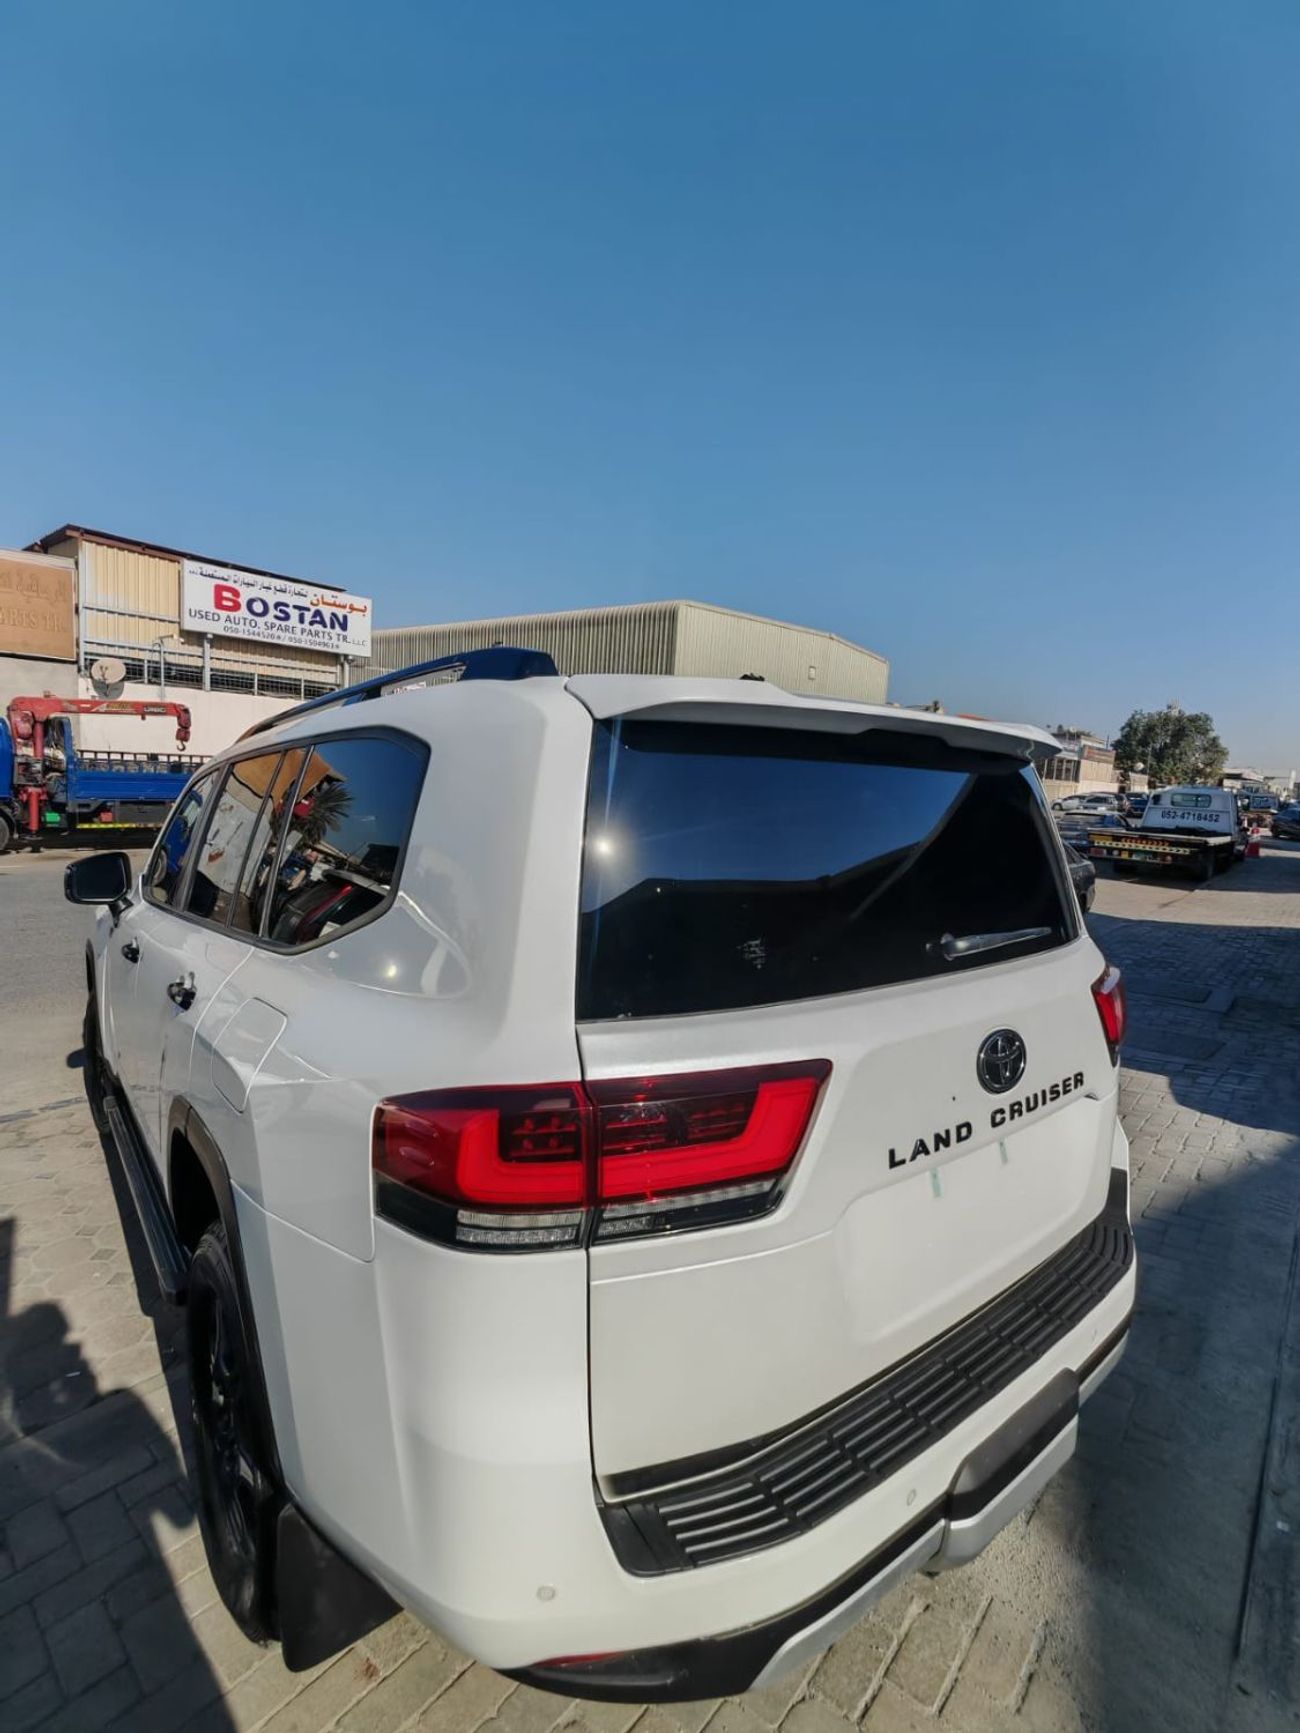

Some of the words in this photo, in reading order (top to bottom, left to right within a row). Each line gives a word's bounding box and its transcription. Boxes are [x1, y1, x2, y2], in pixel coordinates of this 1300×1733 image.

[189, 608, 221, 622] USED
[264, 621, 297, 636] SPARE
[301, 628, 333, 641] PARTS
[214, 583, 348, 632] BOSTAN
[887, 1121, 973, 1169] LAND
[990, 1071, 1085, 1129] CRUISER
